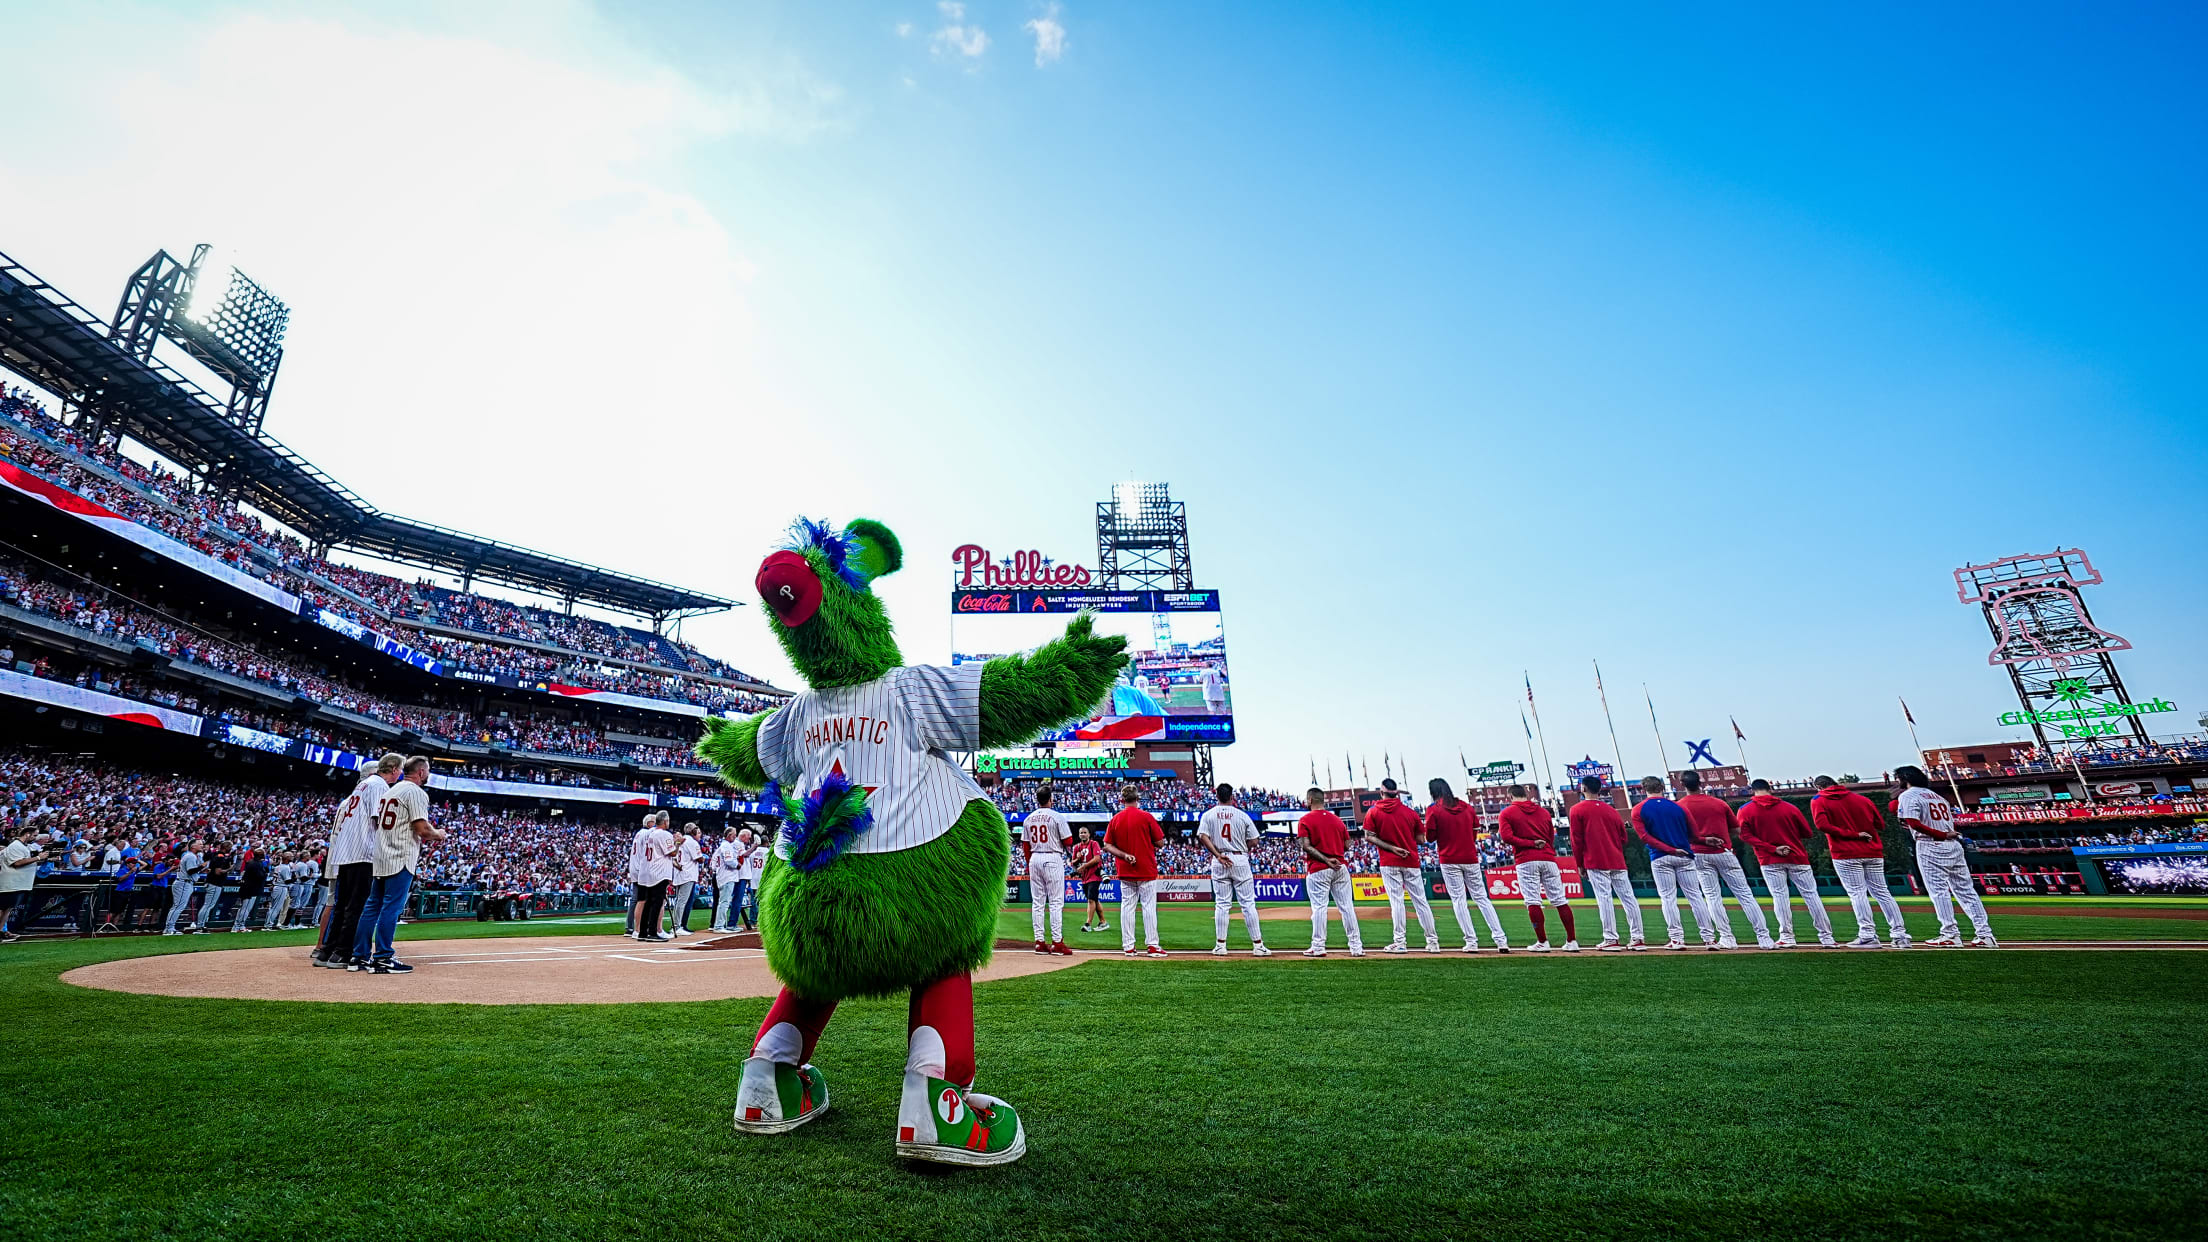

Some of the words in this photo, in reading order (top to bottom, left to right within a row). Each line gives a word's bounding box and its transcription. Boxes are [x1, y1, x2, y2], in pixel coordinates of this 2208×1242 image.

[952, 544, 1091, 587] Phillies
[779, 585, 795, 600] P
[958, 594, 1012, 612] Coca-Cola
[484, 675, 496, 684] PM
[2001, 706, 2100, 725] Citizens
[2103, 697, 2172, 716] Bank
[805, 716, 889, 755] PHANATIC
[1169, 723, 1221, 732] Independence
[2061, 721, 2120, 738] Park
[1000, 757, 1057, 770] Citizens
[1060, 757, 1095, 769] Bank
[1097, 755, 1129, 769] Park
[1580, 767, 1595, 777] STAR
[1595, 765, 1614, 776] GAME
[1929, 802, 1950, 821] 68
[2086, 807, 2155, 817] Budweiser
[1030, 825, 1049, 843] 38
[1221, 823, 1232, 842] 4
[942, 1088, 960, 1123] P
